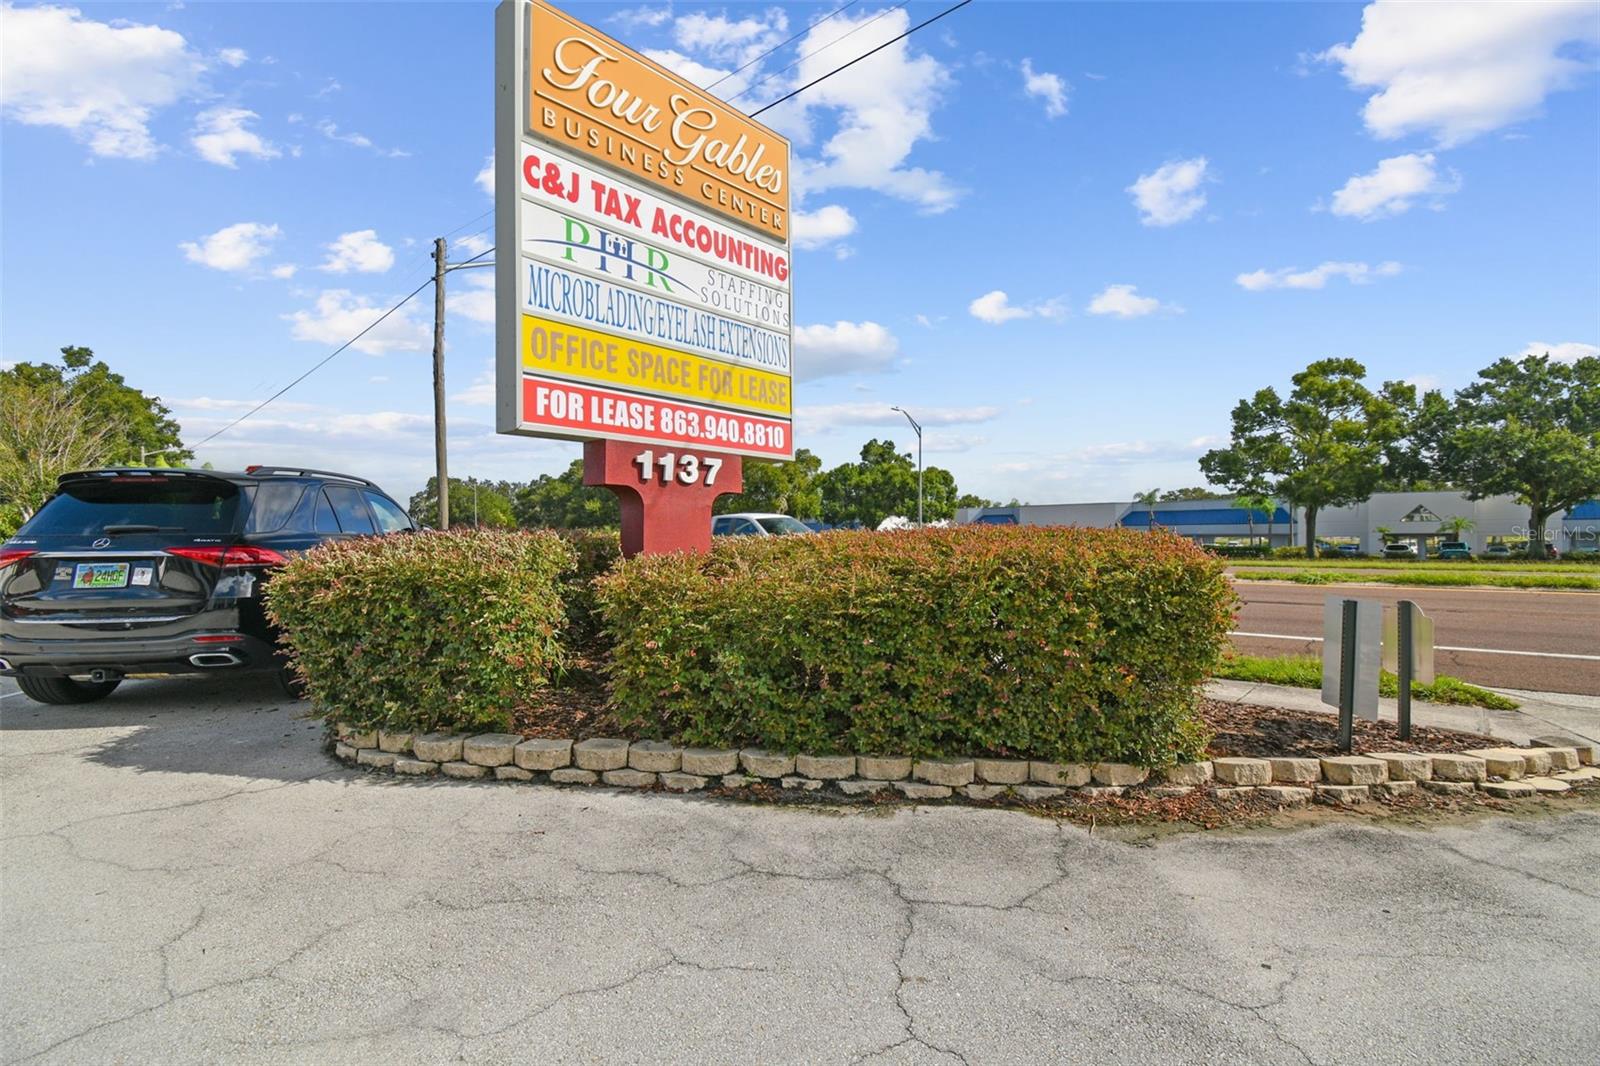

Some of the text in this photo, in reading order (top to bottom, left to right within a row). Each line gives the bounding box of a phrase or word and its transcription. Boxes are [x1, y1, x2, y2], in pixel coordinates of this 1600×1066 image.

[542, 36, 783, 194] Four Gables
[543, 107, 783, 230] BUSINESS CENTER
[523, 155, 788, 282] C&J TAX ACCOUNTING
[561, 216, 676, 294] PHR
[707, 269, 784, 309] STAFFING
[701, 287, 790, 328] SOLUTIONS
[530, 327, 787, 408] OFFICE SPACE FOR LEASE
[719, 320, 788, 369] EXTENSIONS
[536, 387, 785, 449] FOR LEASE 863.940.8810
[635, 450, 723, 486] 1137
